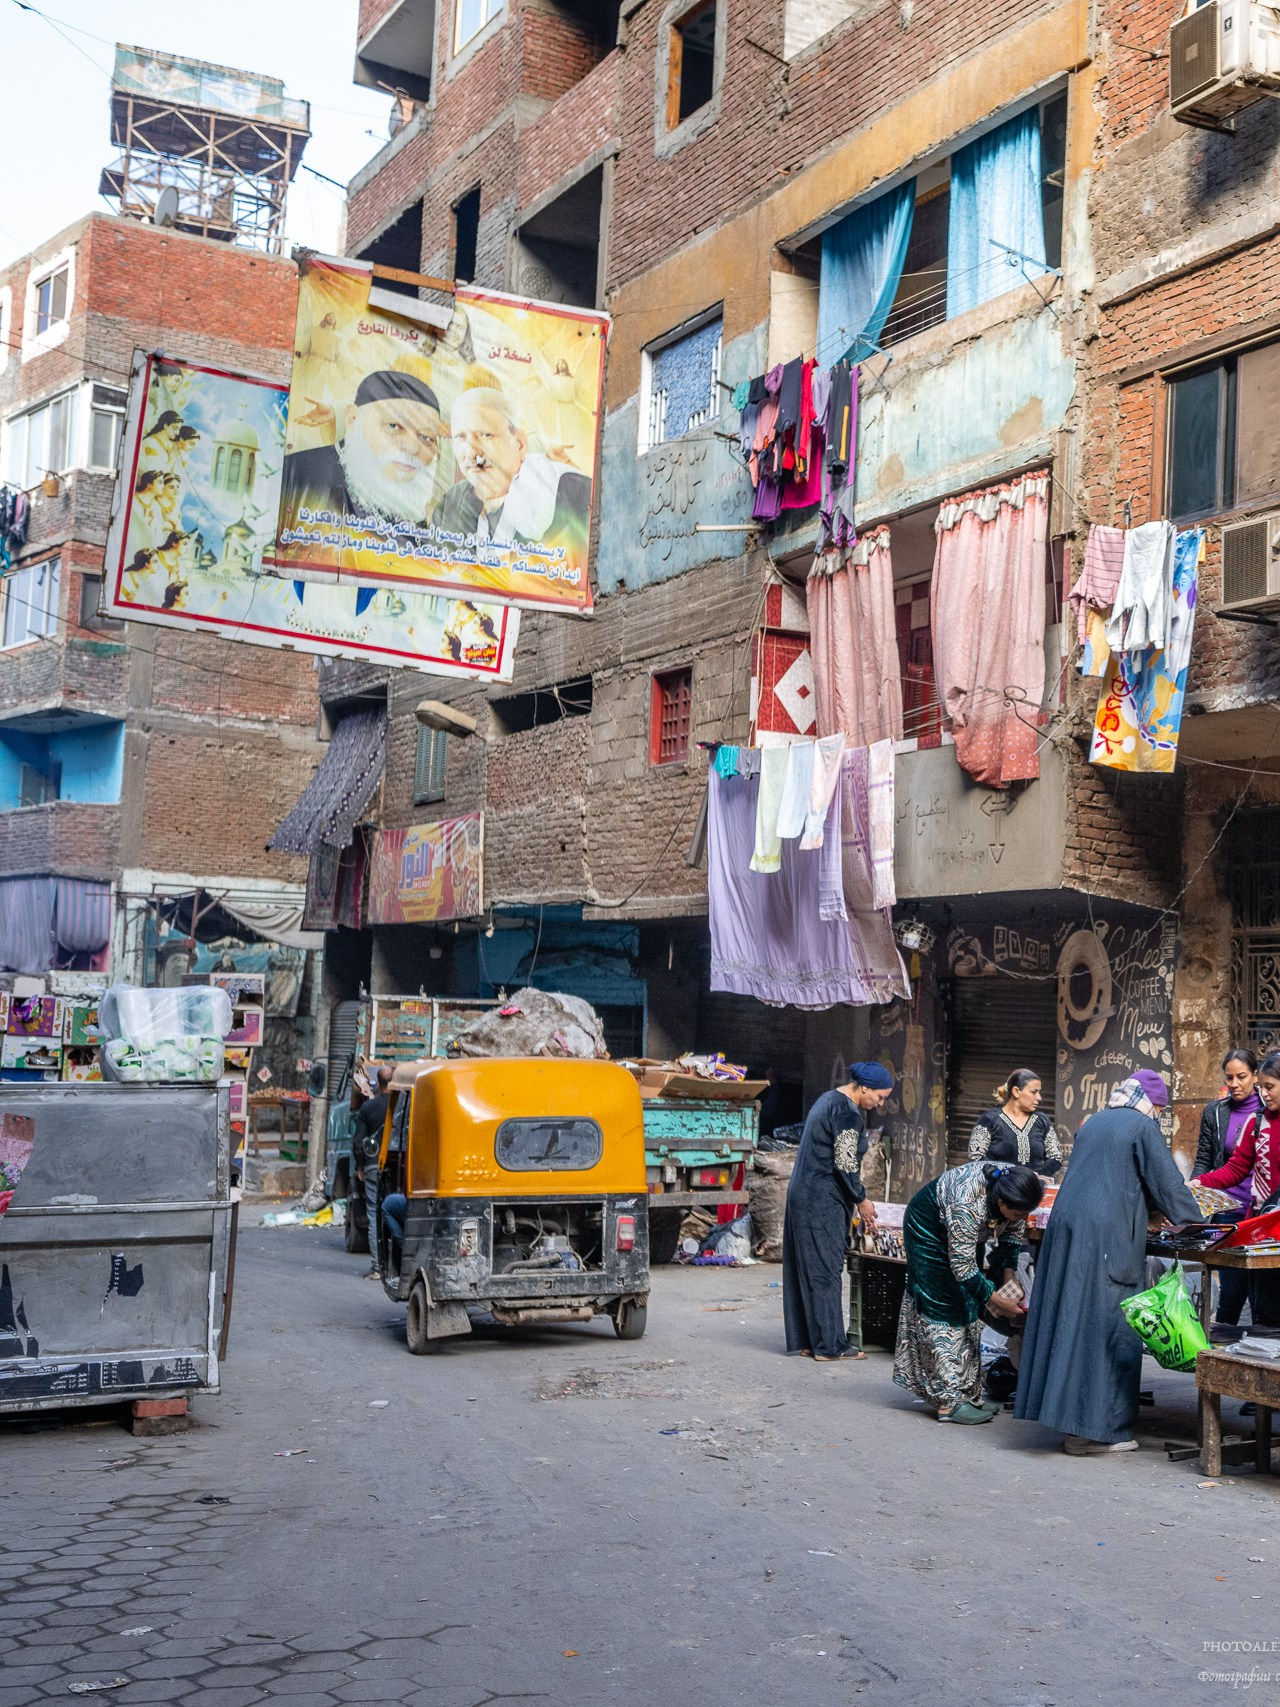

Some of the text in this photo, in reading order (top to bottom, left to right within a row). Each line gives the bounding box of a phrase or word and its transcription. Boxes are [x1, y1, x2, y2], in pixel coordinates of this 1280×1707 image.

[357, 320, 532, 364] نسخة لن يكررها التاريخ
[345, 514, 377, 532] قلوبنا
[377, 518, 392, 534] من
[280, 527, 321, 546] تعيشون
[436, 527, 463, 546] يمحوا
[479, 536, 518, 552] النسيان
[365, 537, 398, 556] قلوبنا
[414, 544, 448, 562] زمانكم
[518, 541, 556, 561] يستطيع
[556, 547, 565, 560] لا
[449, 549, 478, 565] عشتم
[480, 554, 502, 568] فلقد
[511, 561, 547, 577] ننساكم
[548, 567, 560, 580] لن
[1128, 976, 1161, 999] COFFEE
[1140, 997, 1168, 1016] MENU
[1117, 1002, 1165, 1048] Menu
[1080, 1072, 1108, 1113] Try
